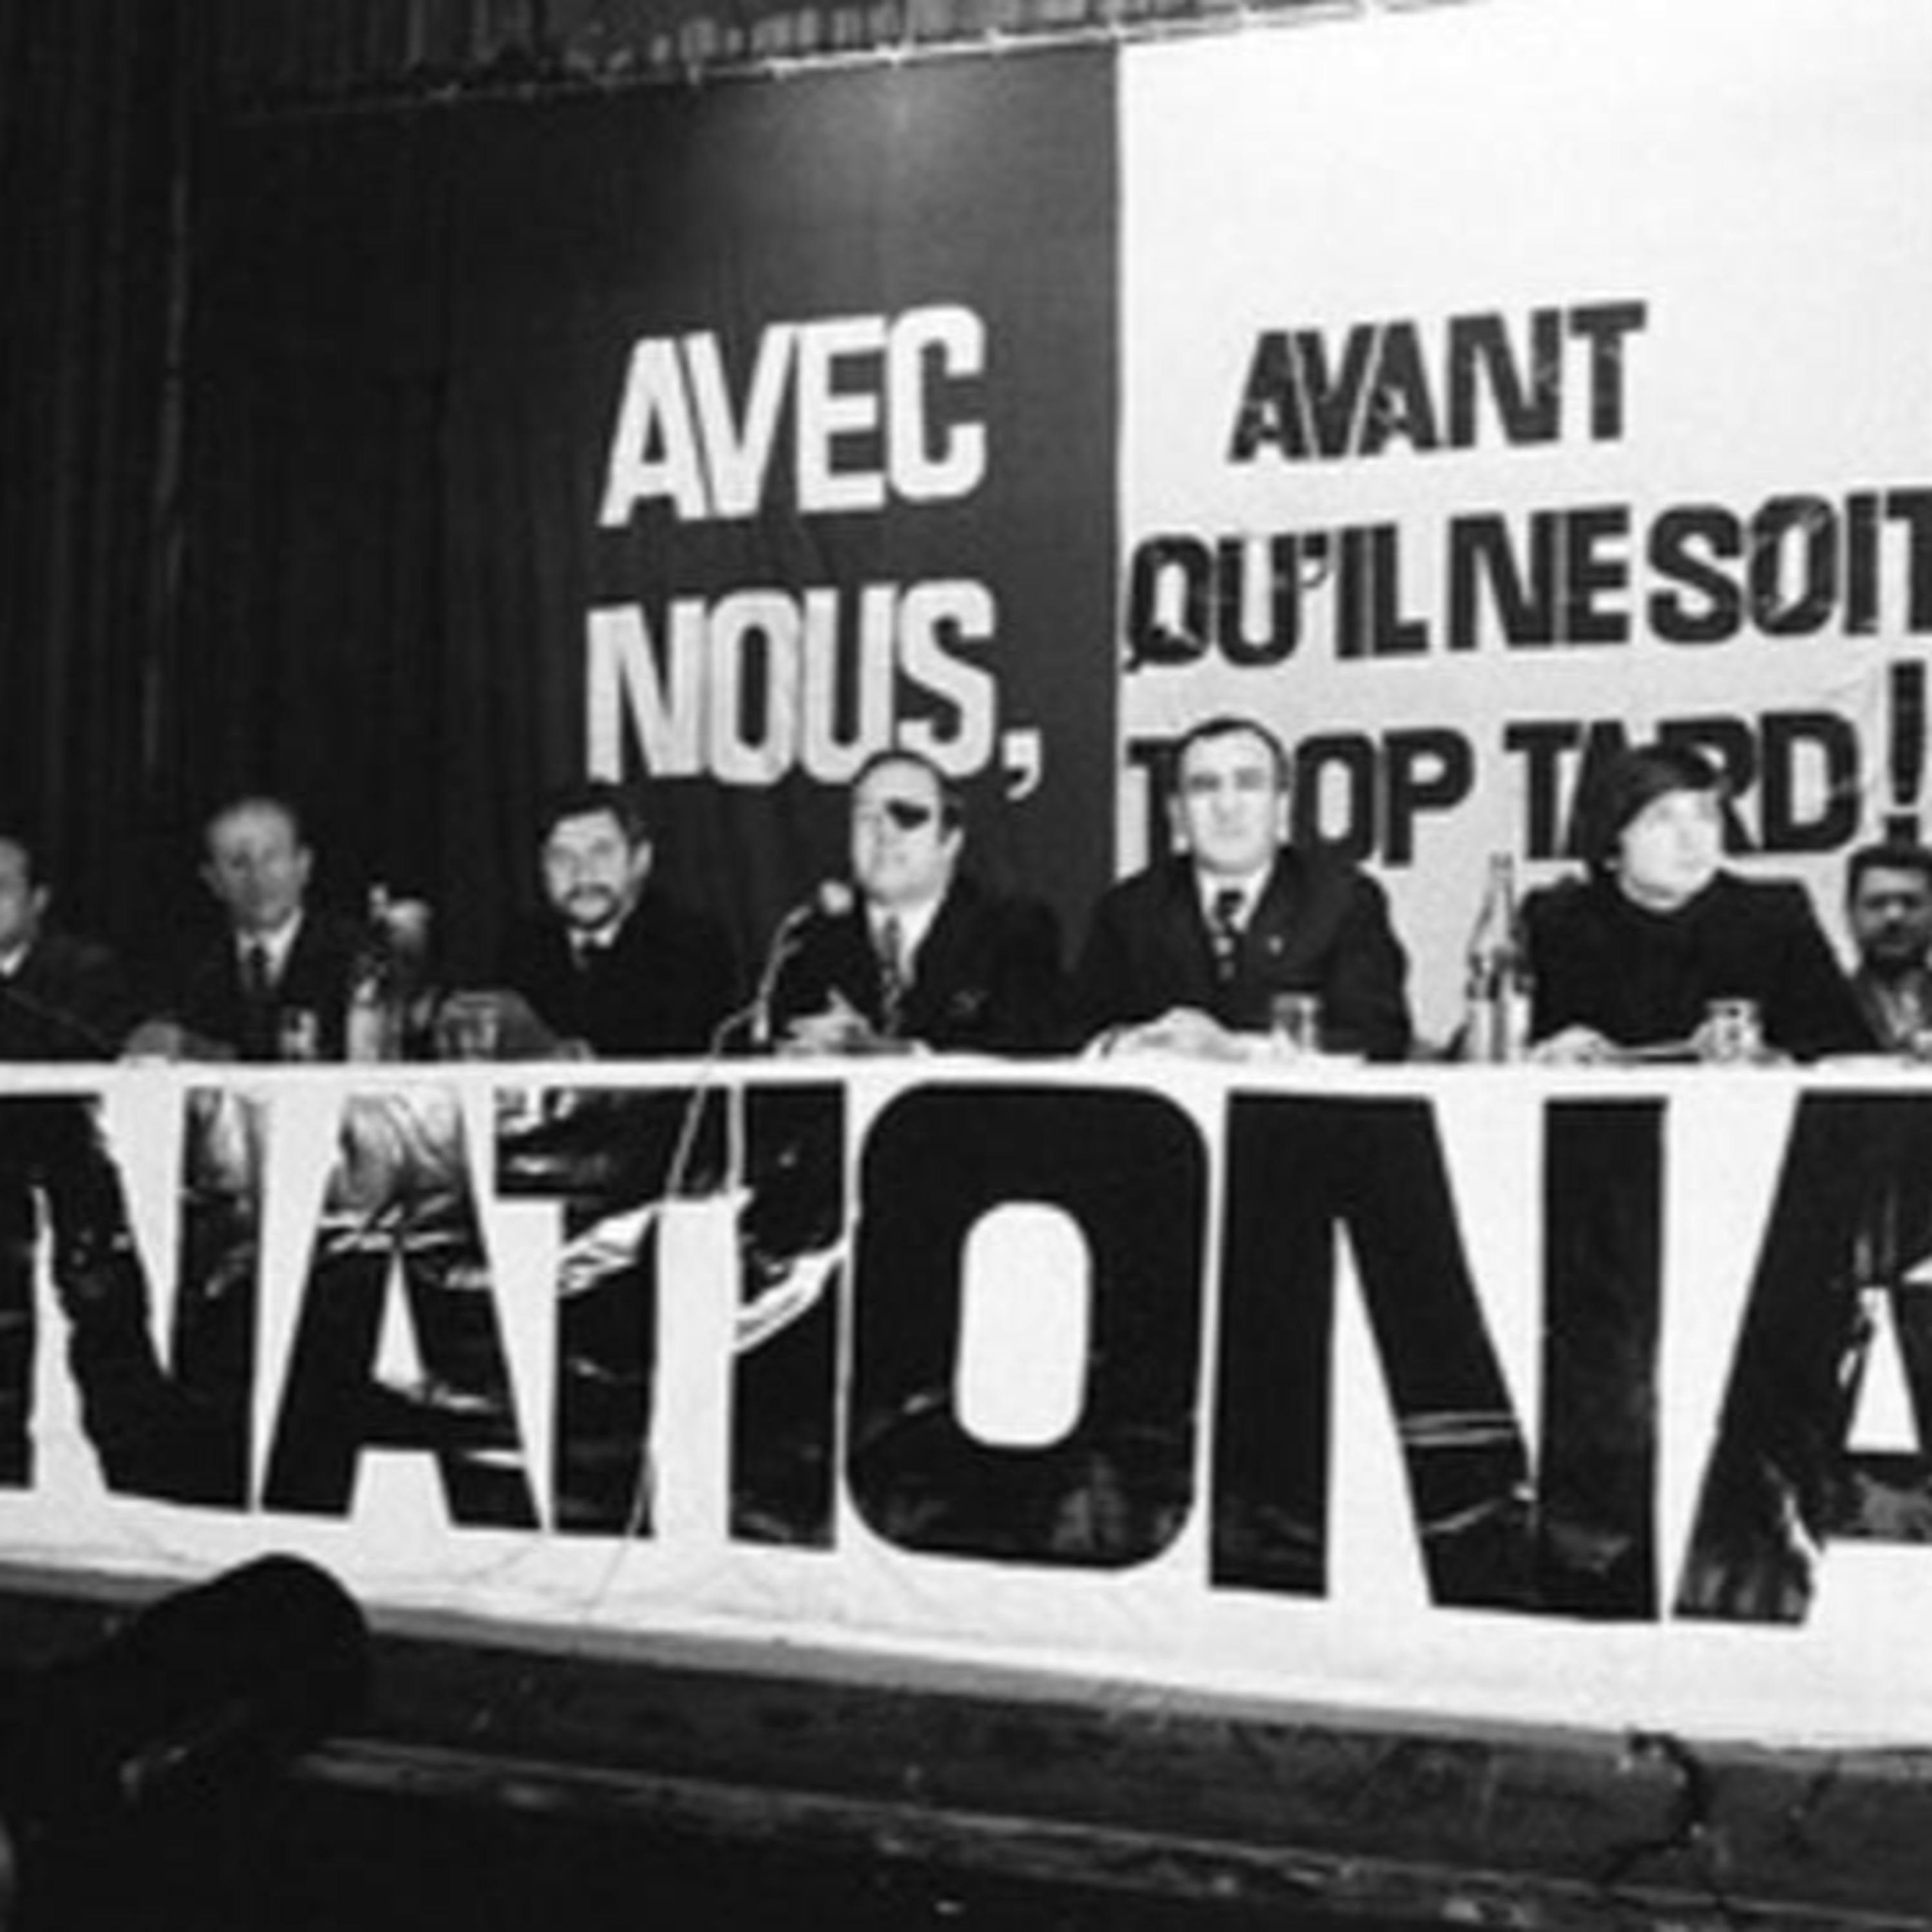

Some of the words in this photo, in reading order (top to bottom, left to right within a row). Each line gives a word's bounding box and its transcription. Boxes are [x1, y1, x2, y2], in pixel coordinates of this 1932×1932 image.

[598, 305, 987, 528] AVEC
[1226, 300, 1647, 464] AVANT
[1122, 520, 1430, 675] QU'IL
[1447, 504, 1631, 652] NE
[1646, 486, 1932, 646] SOIT
[585, 579, 1042, 800] NOUS,
[1126, 726, 1475, 867] TOP
